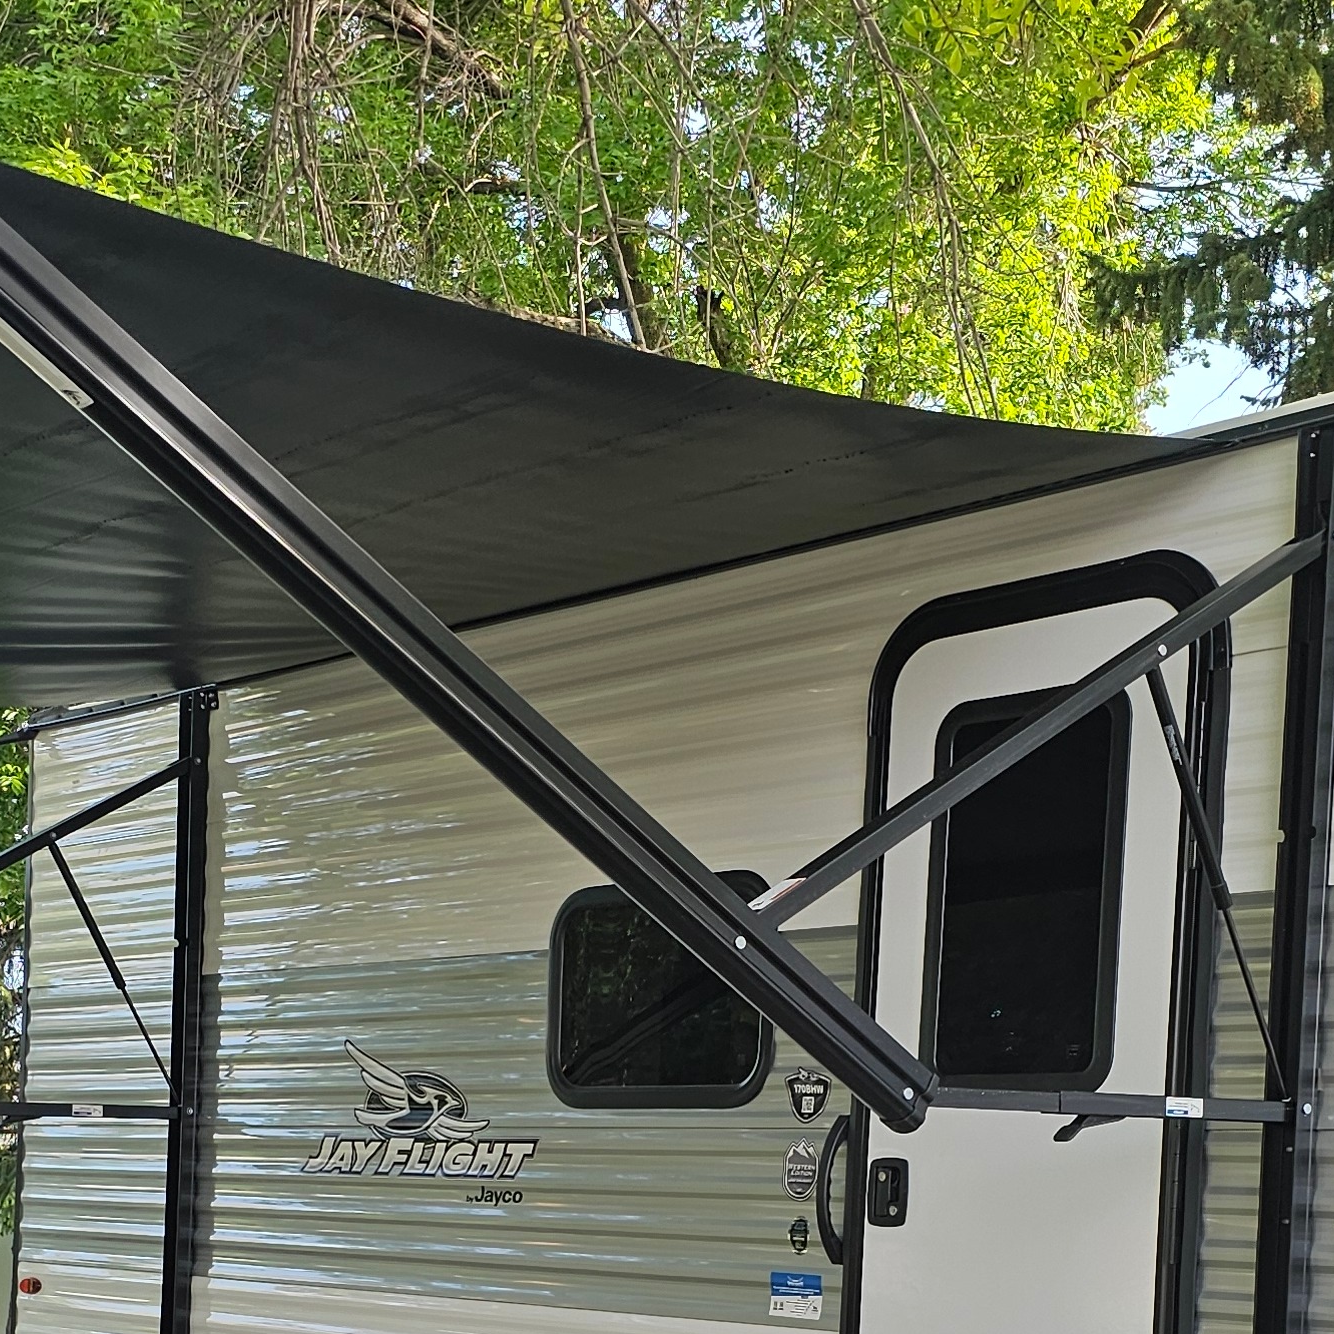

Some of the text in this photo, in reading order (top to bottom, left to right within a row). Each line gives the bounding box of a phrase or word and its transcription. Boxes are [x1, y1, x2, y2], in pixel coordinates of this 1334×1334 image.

[302, 1134, 540, 1181] JAY FLIGHT
[474, 1186, 523, 1207] Jayco
